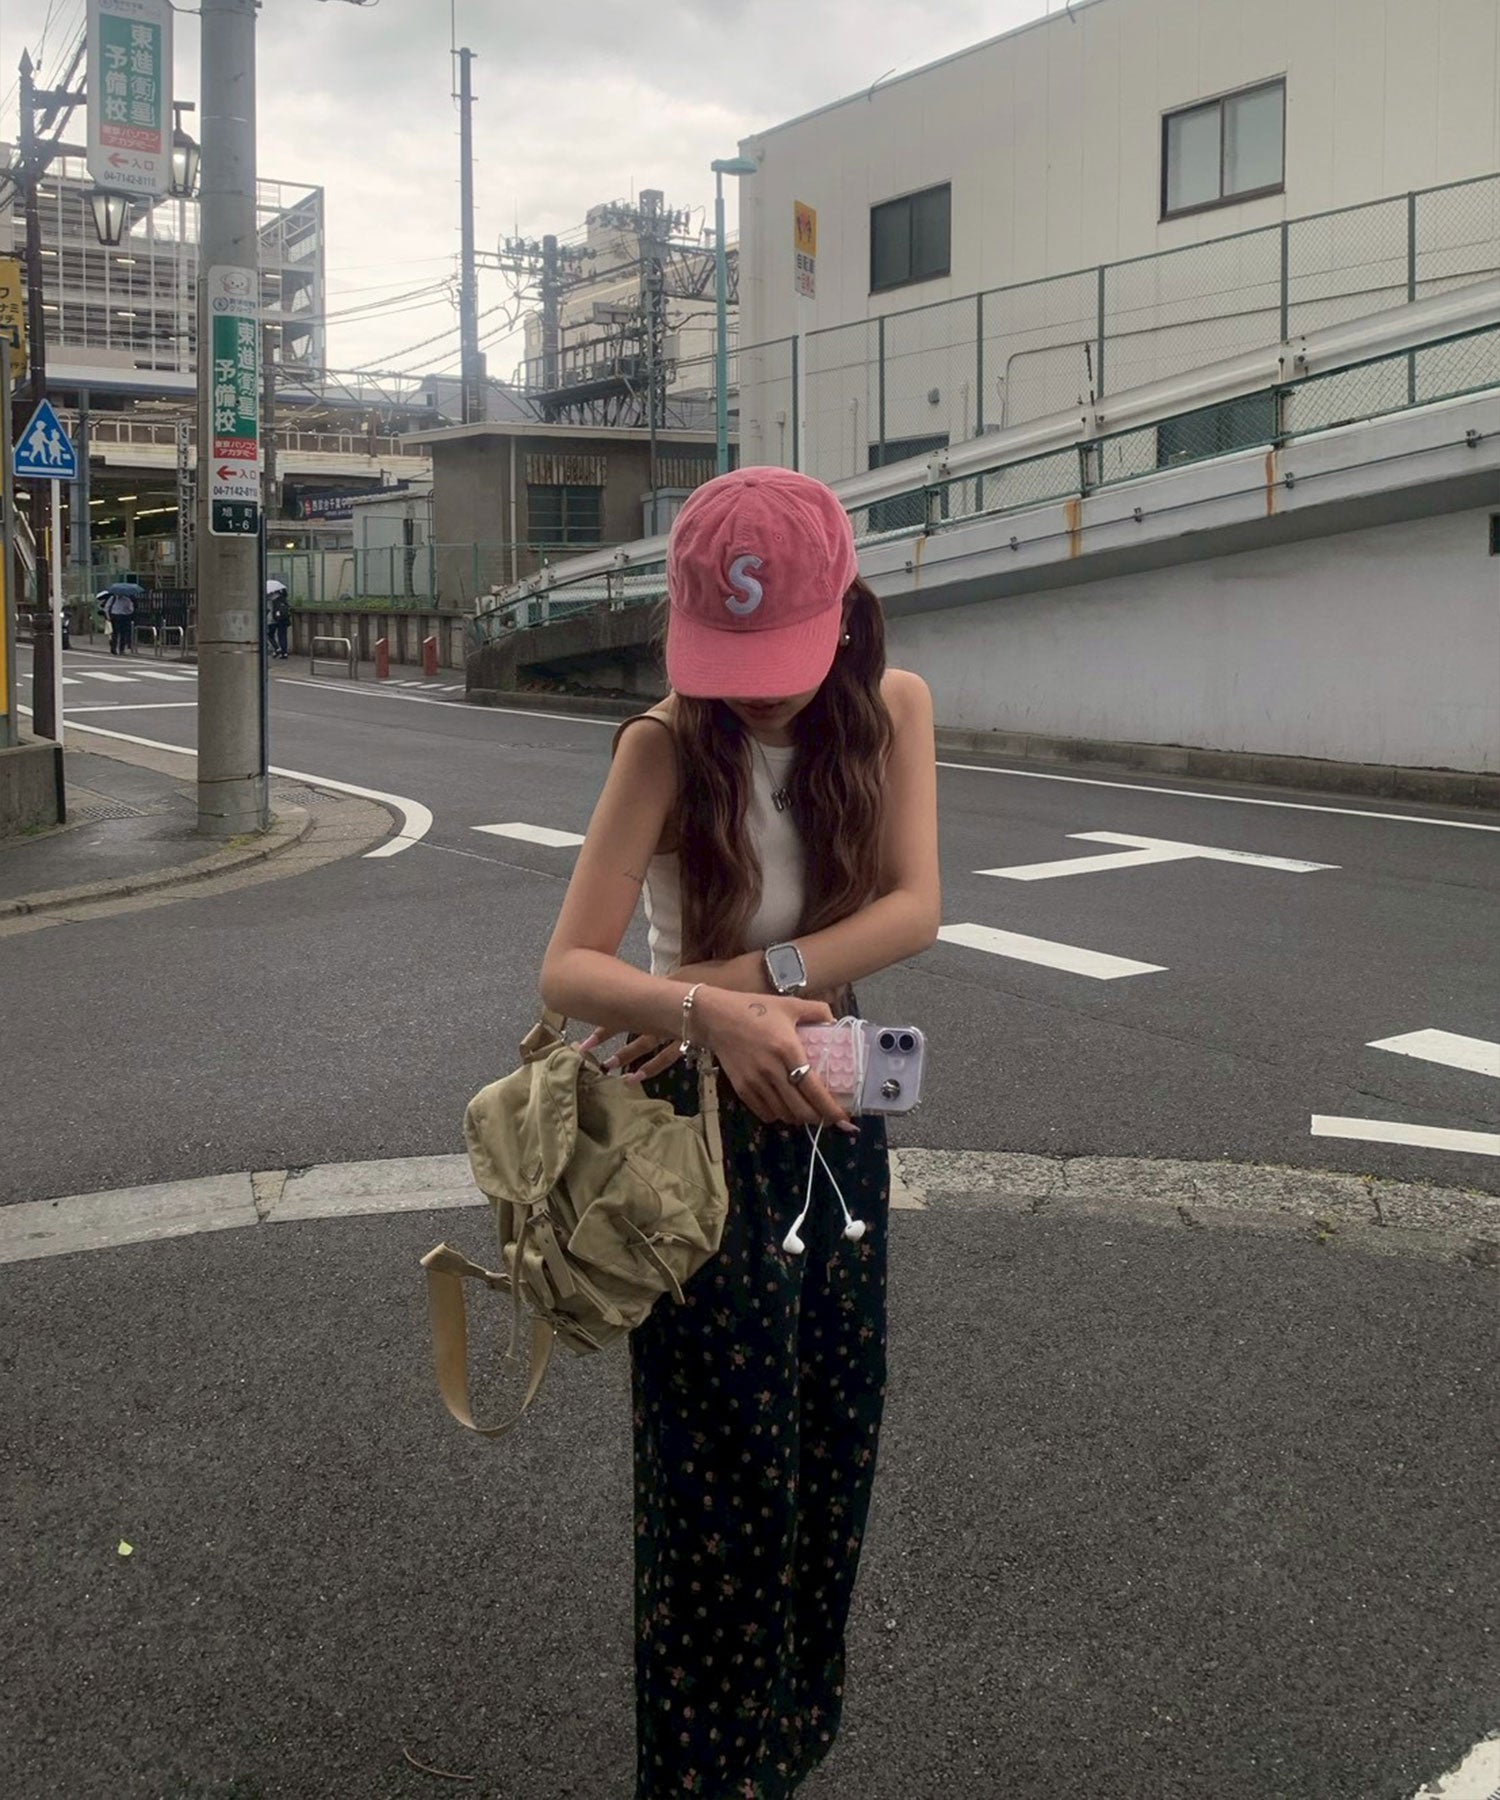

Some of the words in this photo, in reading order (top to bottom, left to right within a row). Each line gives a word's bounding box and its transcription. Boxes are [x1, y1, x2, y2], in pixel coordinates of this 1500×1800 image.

[105, 44, 127, 121] 予備校
[131, 25, 155, 127] 東進衛星
[132, 158, 154, 171] 入口
[215, 358, 236, 432] 予備校
[237, 322, 255, 421] 東進衛星
[240, 469, 257, 480] 入口
[228, 519, 250, 530] 1-6
[725, 555, 763, 615] S
